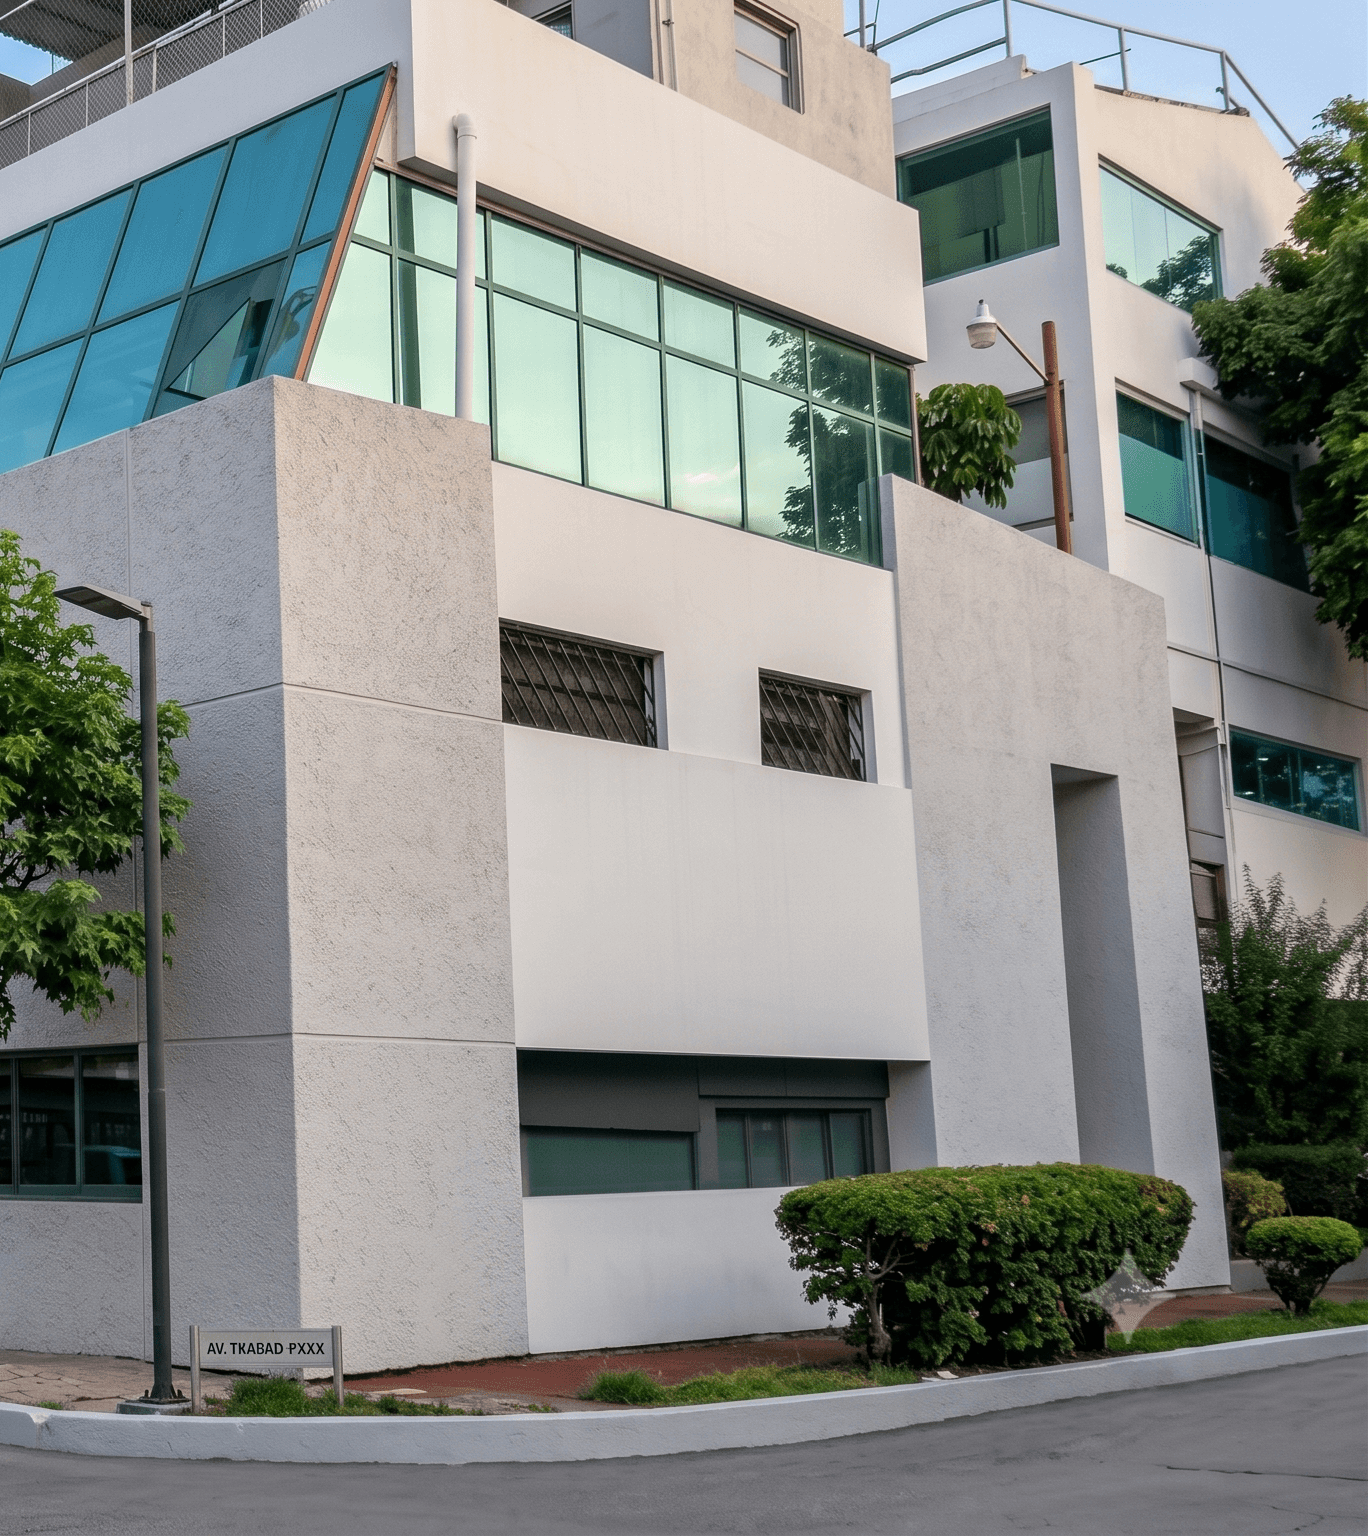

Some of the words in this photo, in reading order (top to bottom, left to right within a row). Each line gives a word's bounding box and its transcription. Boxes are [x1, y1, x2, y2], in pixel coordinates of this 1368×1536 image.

[206, 1342, 227, 1355] AV.
[229, 1342, 284, 1355] TKABAD
[288, 1342, 325, 1355] PXXX
